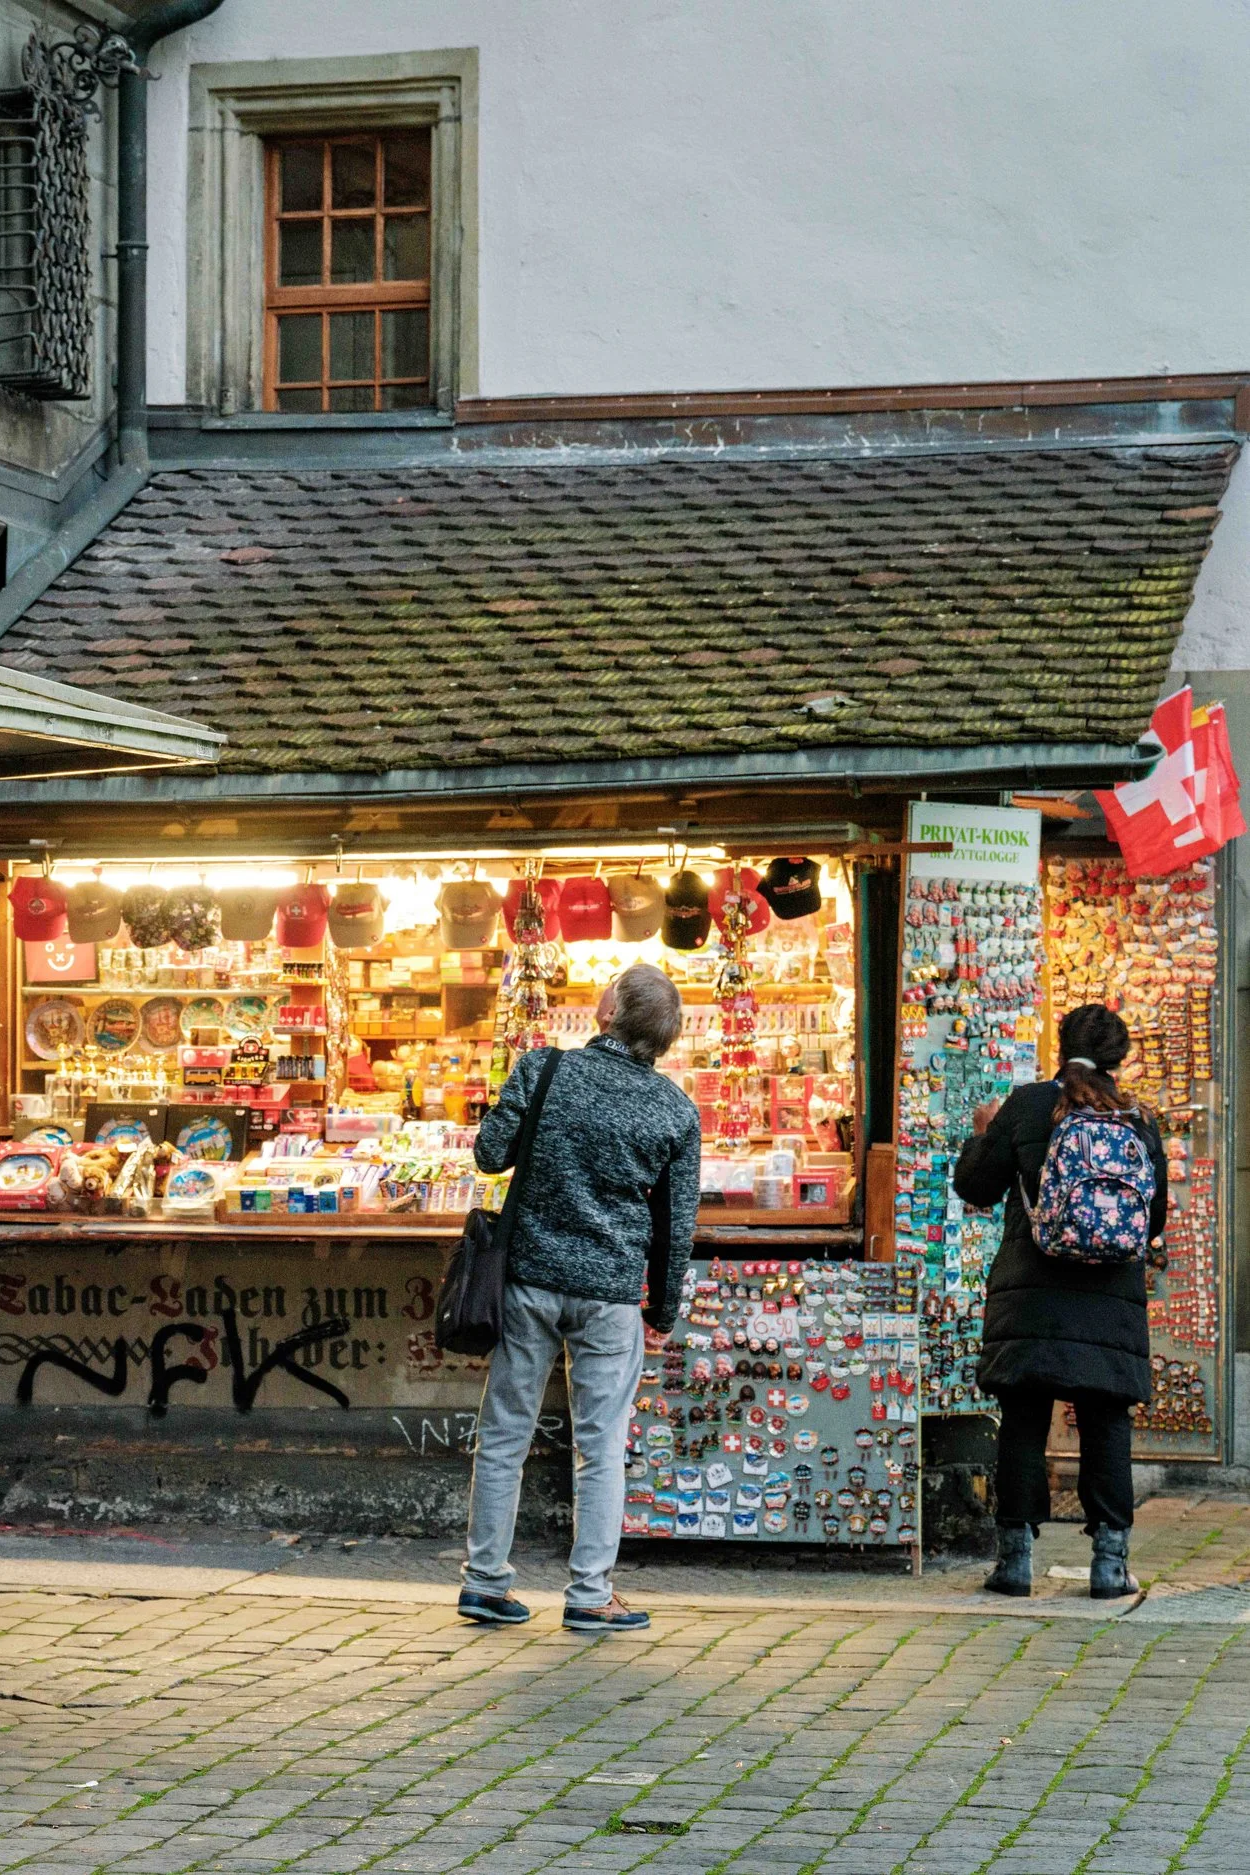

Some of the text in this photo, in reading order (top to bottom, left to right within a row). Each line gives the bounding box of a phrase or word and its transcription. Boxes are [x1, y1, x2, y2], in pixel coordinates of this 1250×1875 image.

[919, 823, 1030, 847] PRIVAT-KIOSK
[953, 849, 1021, 864] ZYTGLOGGE
[301, 1287, 389, 1328] zum
